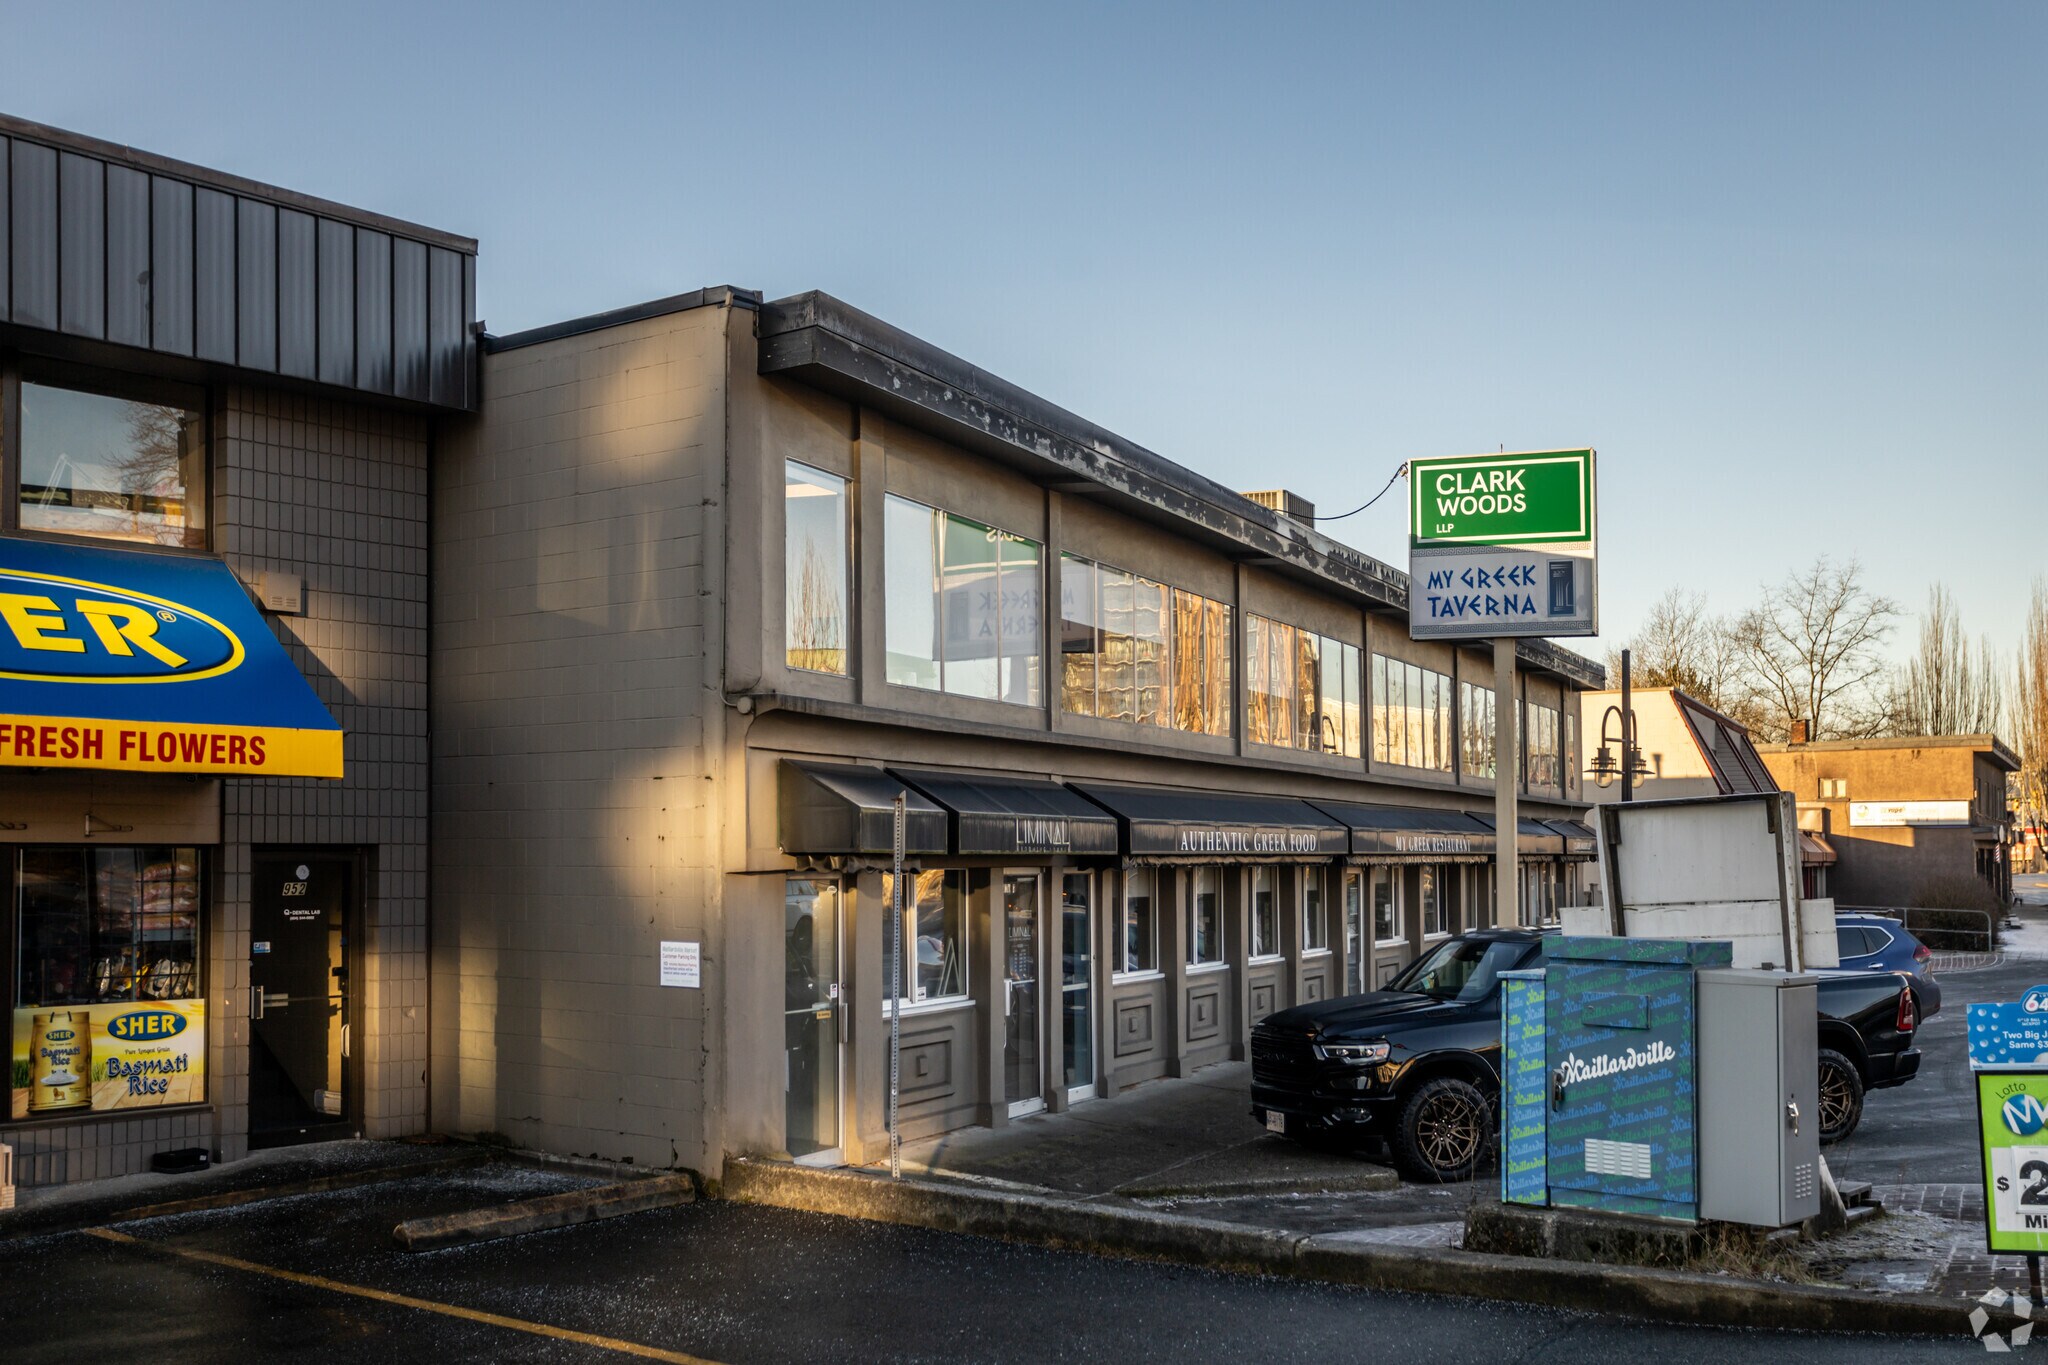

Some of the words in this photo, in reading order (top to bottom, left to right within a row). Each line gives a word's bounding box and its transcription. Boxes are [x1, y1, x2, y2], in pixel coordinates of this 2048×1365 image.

[1436, 469, 1526, 495] CLARK
[1436, 493, 1527, 516] WOODS
[1436, 523, 1454, 533] LLP
[1427, 570, 1453, 590] MY
[1460, 564, 1536, 589] GREEK
[1427, 593, 1537, 618] TAVERNA
[0, 724, 103, 760] FRESH
[119, 730, 266, 766] FLOWERS
[1016, 818, 1070, 845] LIMINAL
[1180, 830, 1250, 852] AUTHENTIC
[1253, 832, 1287, 852] GREEK
[1290, 833, 1316, 852] FOOD
[1395, 836, 1406, 851] MY
[1408, 836, 1431, 852] GREEK
[1432, 837, 1471, 852] RESTAURANT
[283, 883, 306, 896] 952
[48, 1031, 72, 1040] SHER
[116, 1014, 178, 1037] SHER
[2002, 1031, 2022, 1039] Two
[2025, 1030, 2040, 1040] Big
[2009, 1041, 2035, 1049] Same
[106, 1053, 189, 1078] Basmati
[1561, 1040, 1676, 1087] Maillardville
[127, 1075, 169, 1096] Rice
[1995, 1082, 2027, 1100] Lotto
